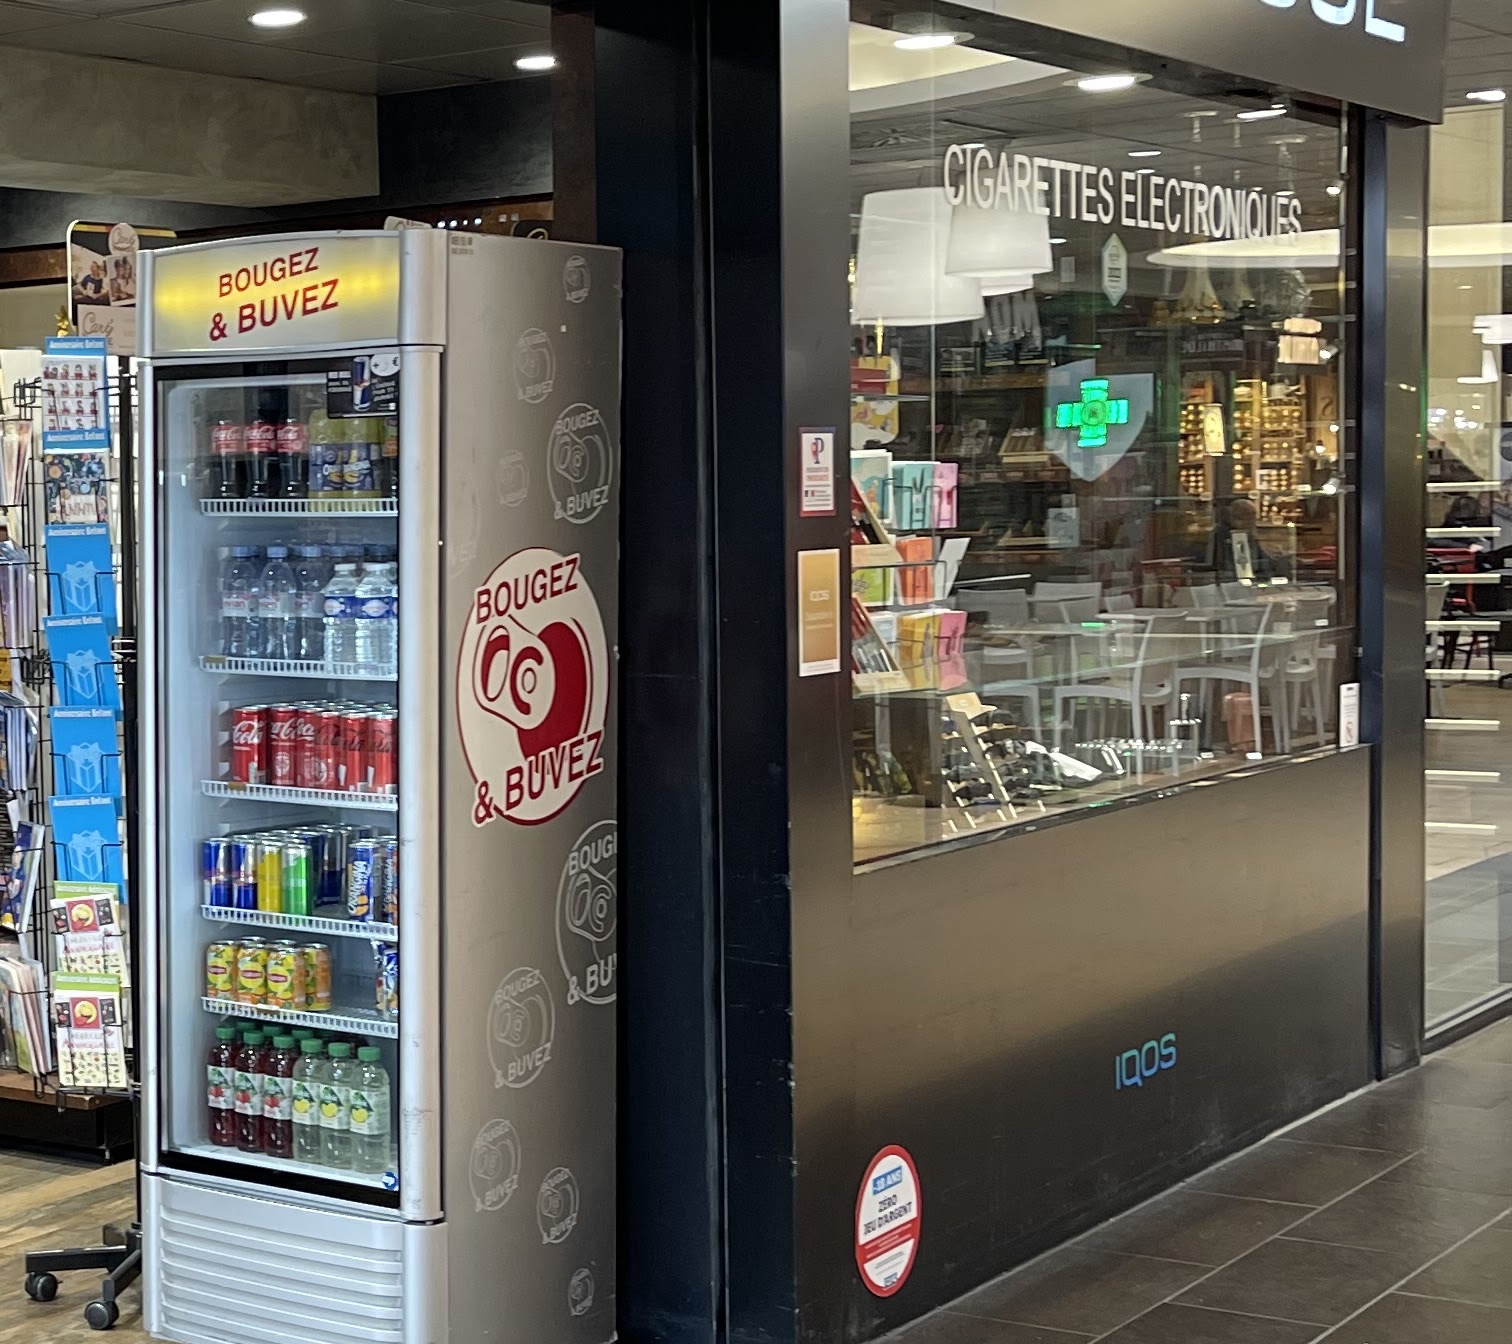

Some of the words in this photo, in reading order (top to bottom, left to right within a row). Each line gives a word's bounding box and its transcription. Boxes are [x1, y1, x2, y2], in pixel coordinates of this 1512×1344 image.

[943, 144, 1114, 225] CIGARETTES
[1120, 170, 1302, 240] ELECTRONIQUES
[218, 246, 319, 297] BOUGEZ
[209, 312, 227, 342] &
[238, 279, 339, 334] BUVEZ
[555, 409, 600, 435] BOUGEZ
[566, 484, 610, 515] BUVEZ
[476, 556, 579, 624] BOUGEZ
[474, 782, 494, 824] &
[504, 730, 603, 807] BUVEZ
[1115, 1033, 1176, 1090] IQOS
